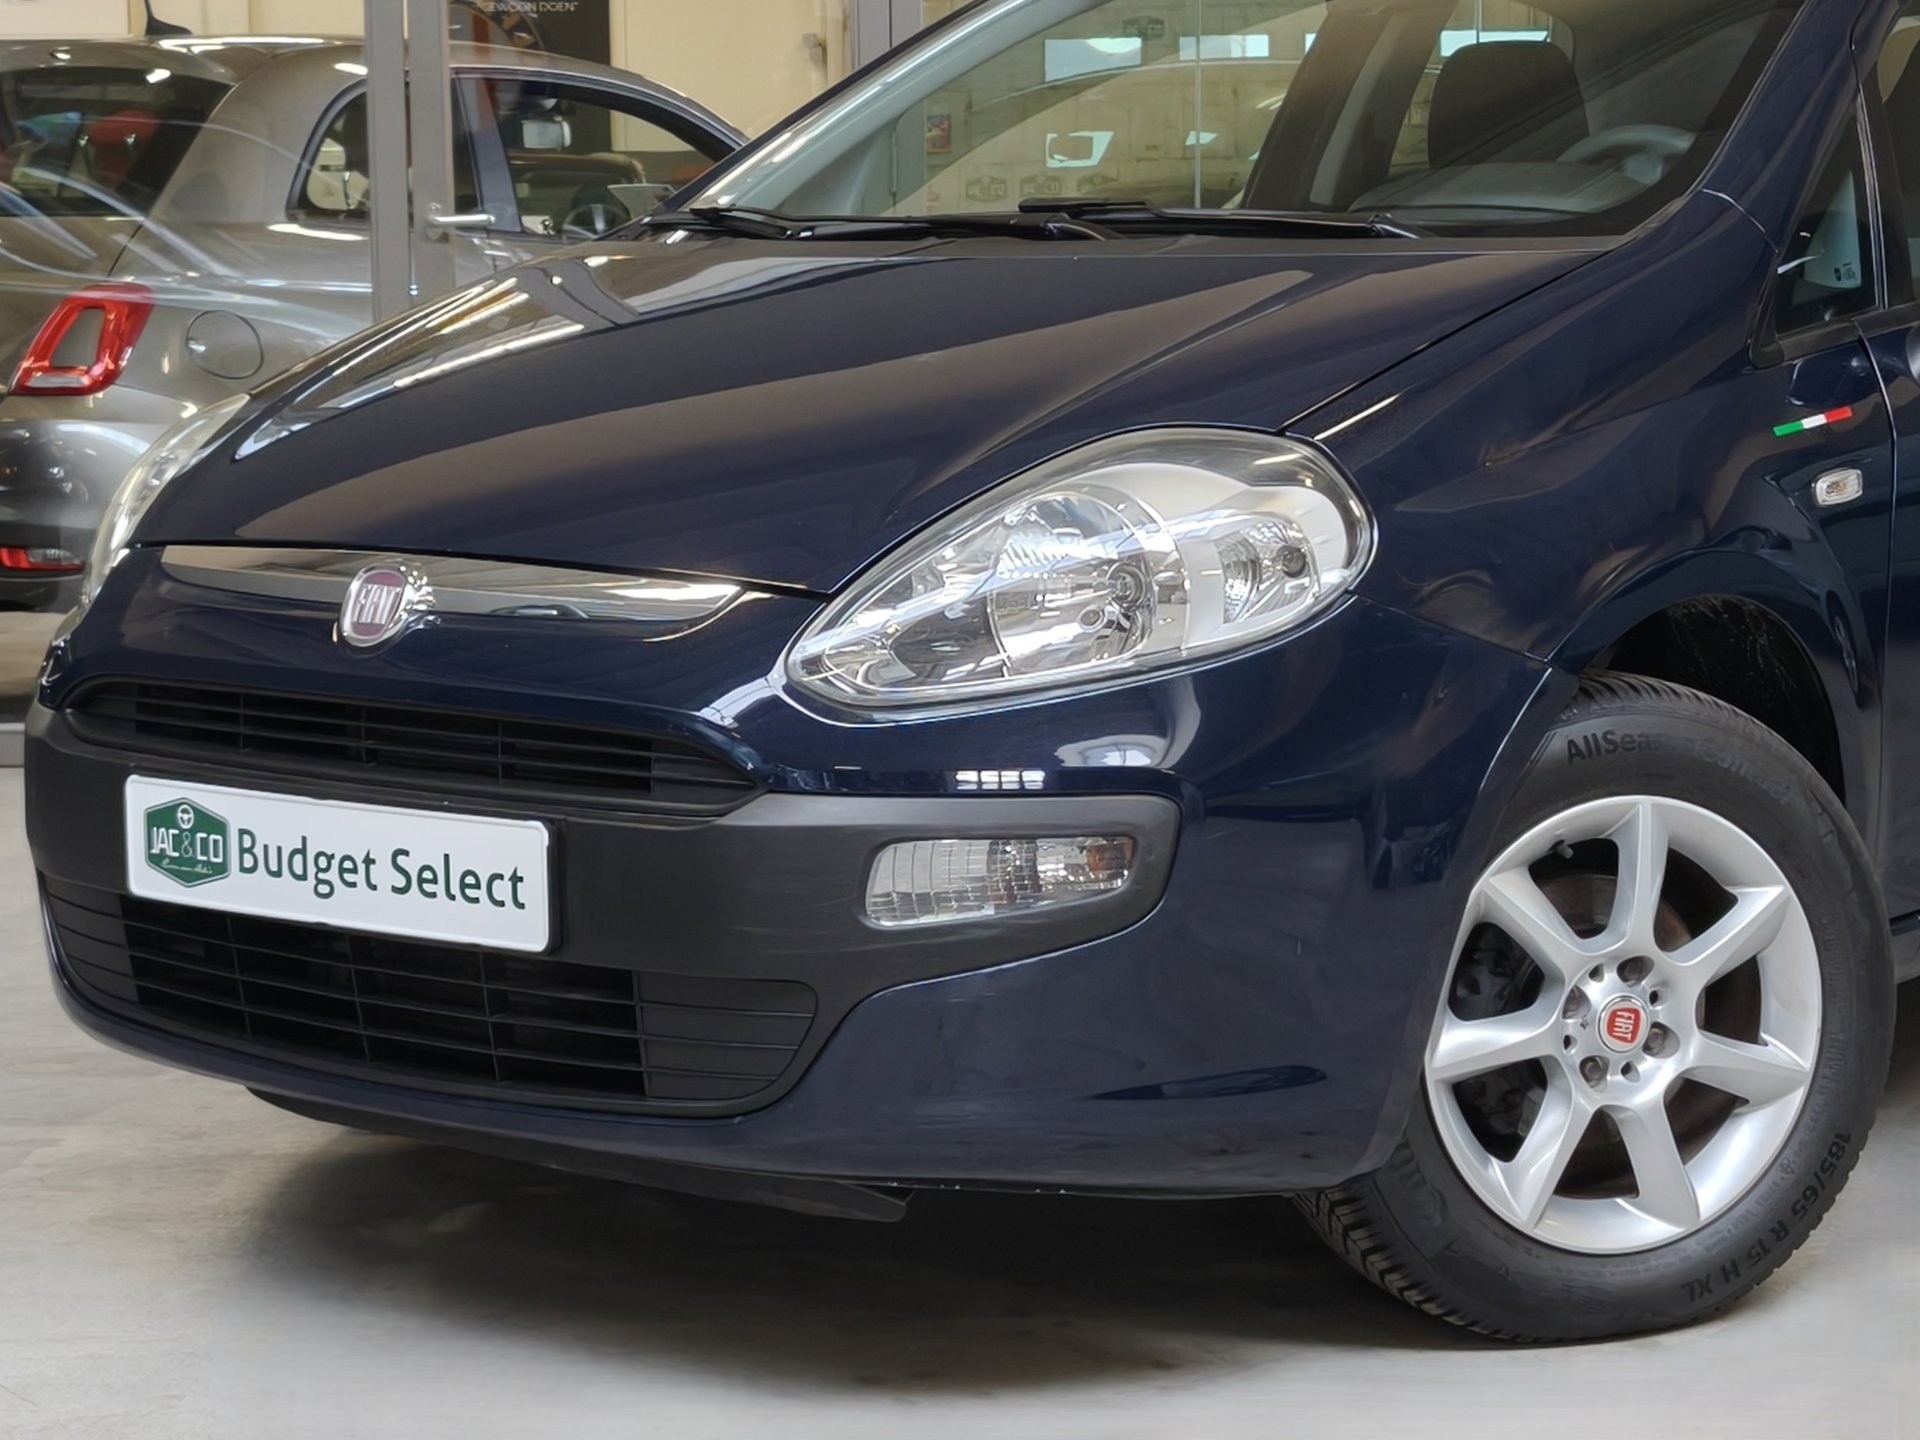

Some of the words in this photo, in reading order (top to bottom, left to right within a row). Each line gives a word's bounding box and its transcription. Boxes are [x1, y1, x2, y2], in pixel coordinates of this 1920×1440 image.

[353, 583, 402, 625] FIAT
[237, 828, 378, 900] Budget
[391, 847, 526, 910] Select
[1612, 1010, 1636, 1041] FIAT
[1791, 1131, 1852, 1221] 185/65
[1767, 1218, 1790, 1243] R
[1747, 1237, 1772, 1267] 15
[1721, 1258, 1742, 1285] H
[1680, 1272, 1714, 1303] XL
